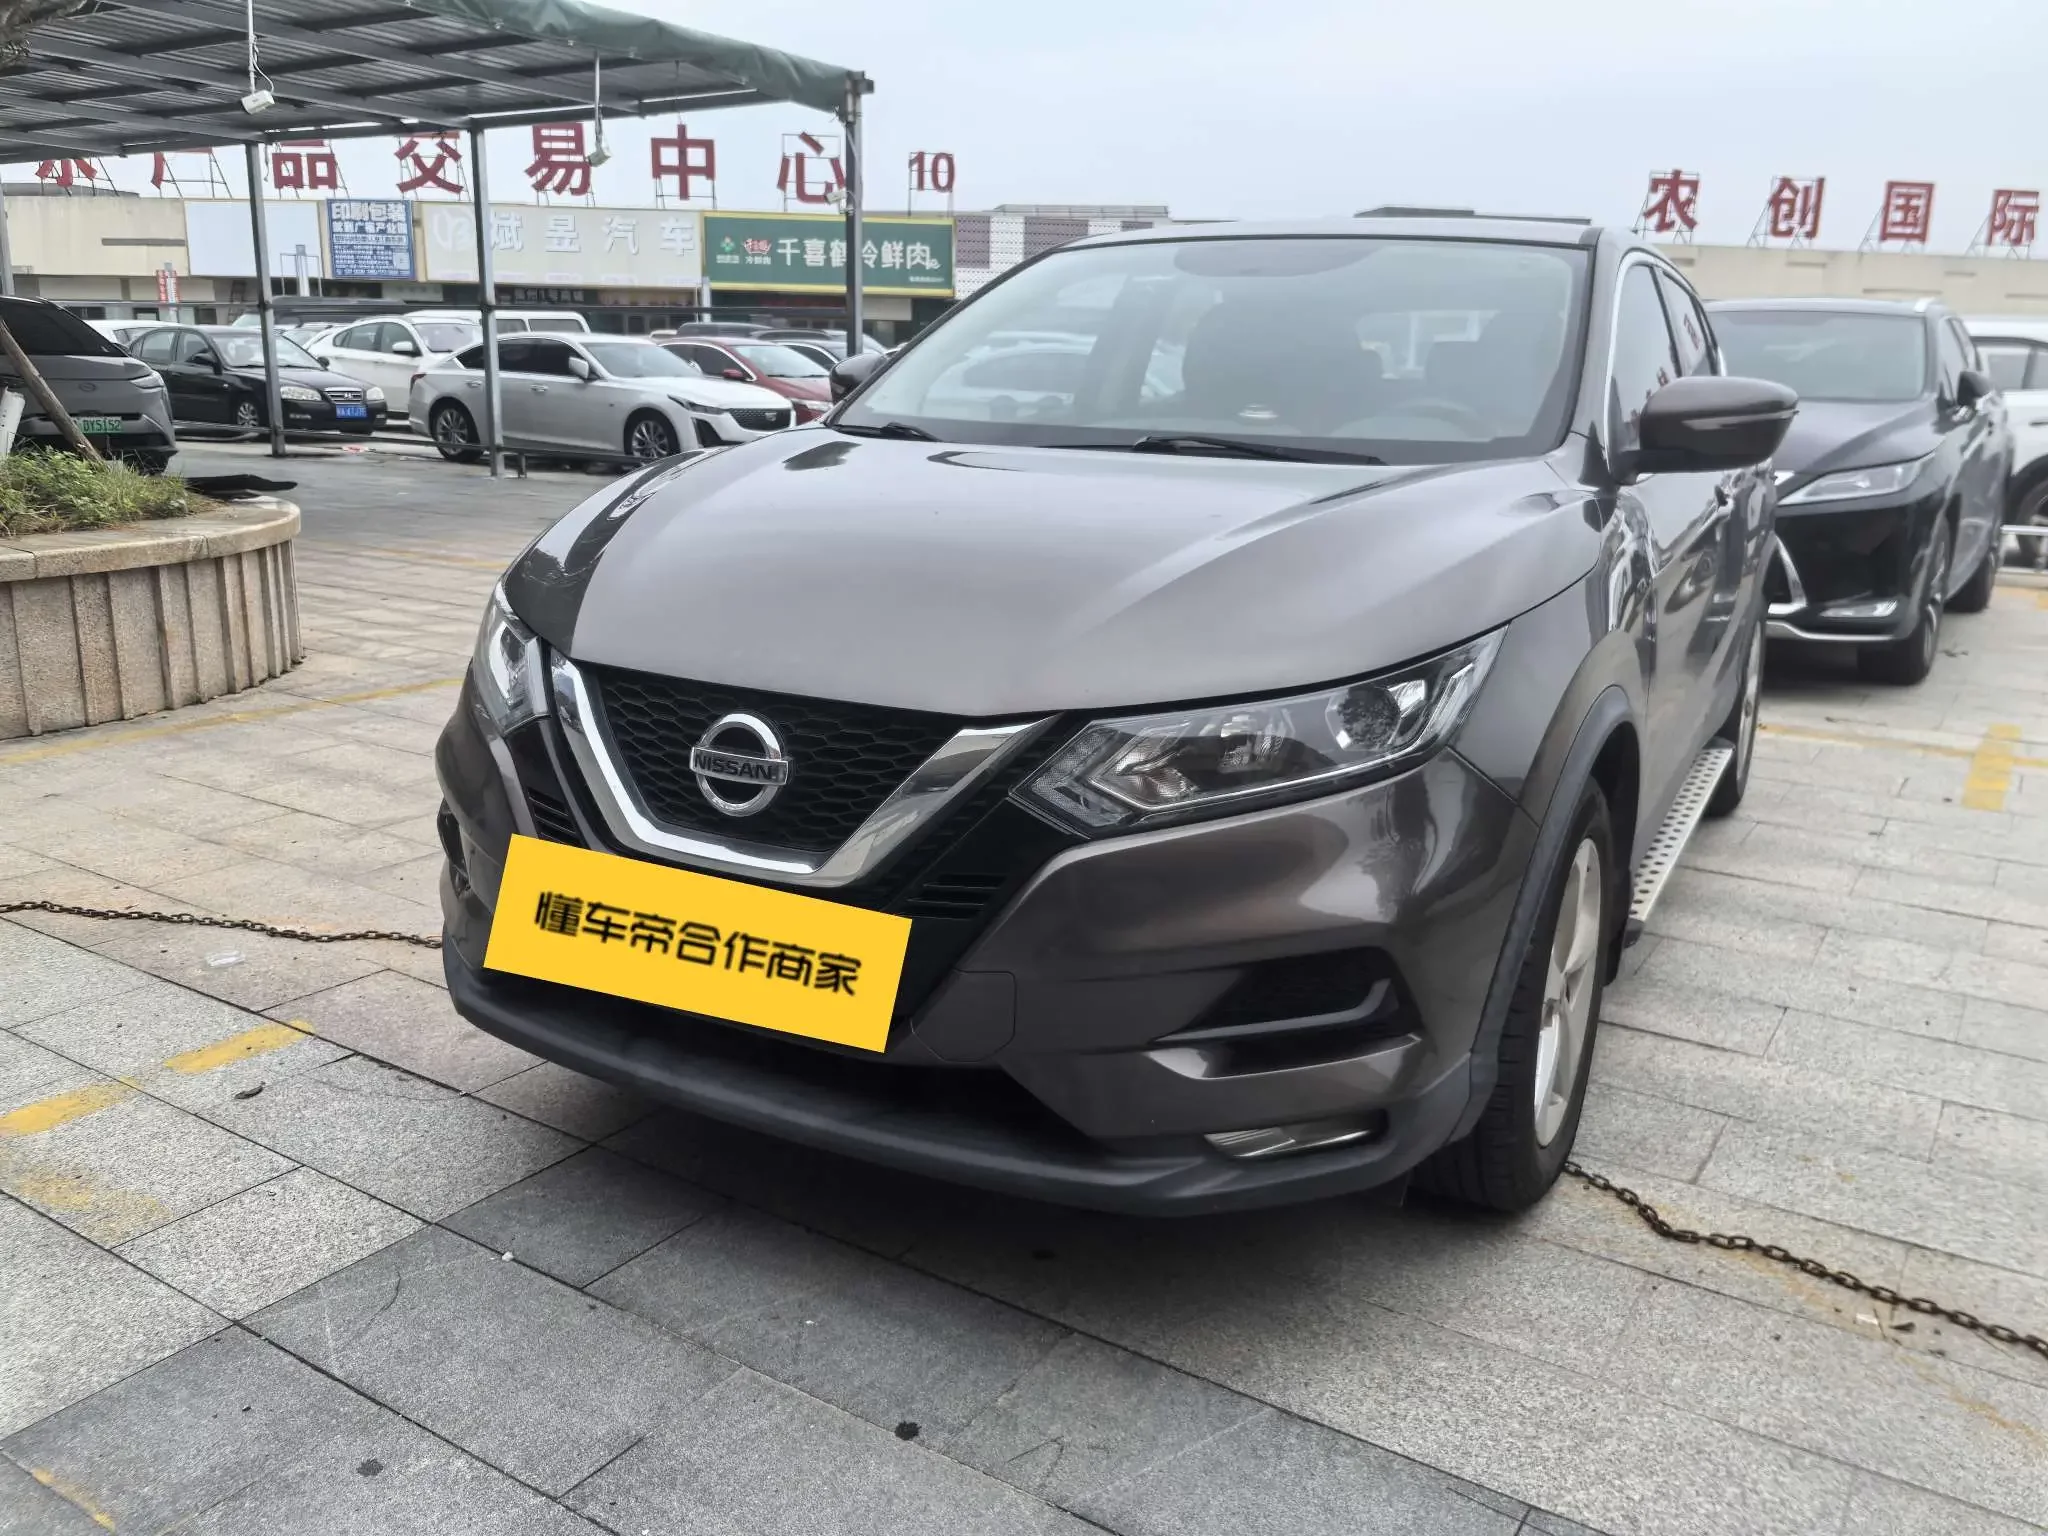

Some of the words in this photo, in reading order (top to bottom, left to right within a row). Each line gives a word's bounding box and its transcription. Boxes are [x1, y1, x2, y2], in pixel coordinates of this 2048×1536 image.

[1643, 169, 2039, 247] 农创国际
[695, 750, 772, 779] NISSAN
